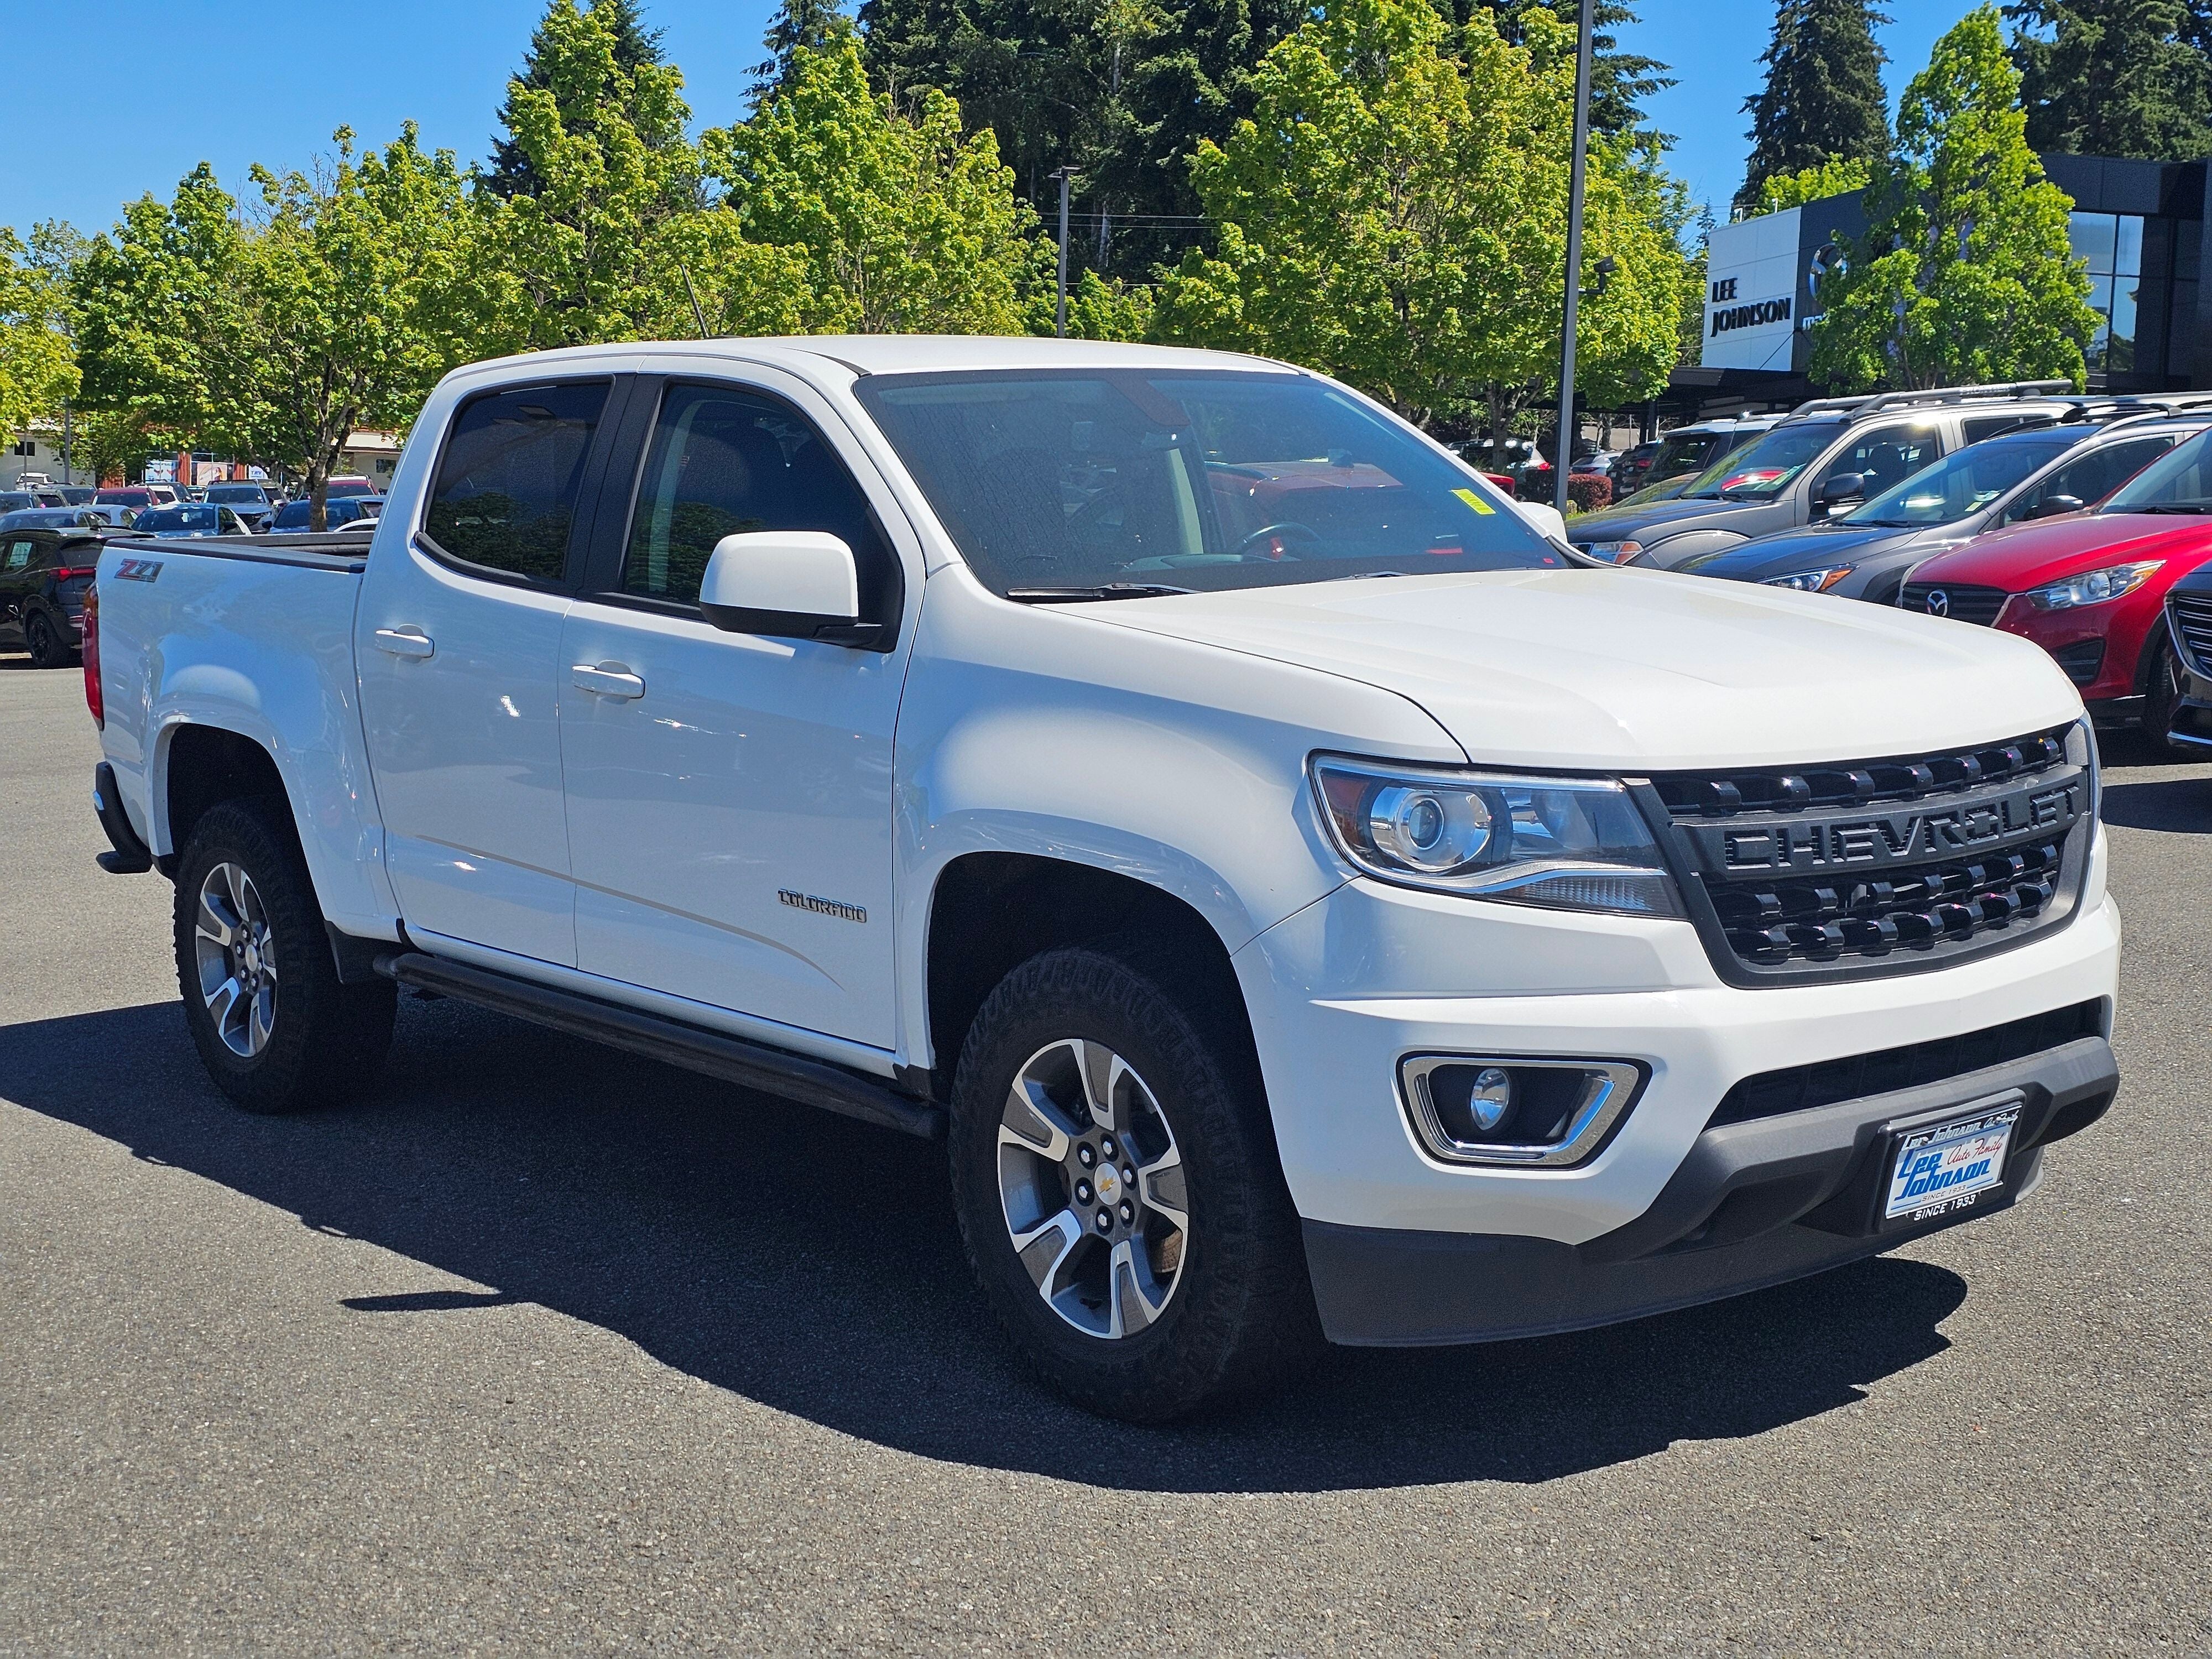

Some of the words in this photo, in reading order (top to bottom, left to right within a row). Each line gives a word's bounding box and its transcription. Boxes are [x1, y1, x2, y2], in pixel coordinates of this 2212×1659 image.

[1712, 278, 1738, 302] LEE
[1710, 298, 1791, 337] JOHNSON
[114, 559, 164, 583] Z71
[1724, 781, 2080, 870] CHEVROLET
[778, 889, 867, 923] COLORADO
[1897, 1148, 1943, 1179] Lee
[1947, 1144, 1970, 1165] Auto
[1972, 1133, 2005, 1159] Family
[1894, 1158, 1991, 1201] Johnson
[1922, 1191, 1947, 1202] SINCE
[1949, 1185, 1968, 1195] 1933
[1914, 1203, 1948, 1221] SINCE
[1951, 1194, 1976, 1211] 1933
